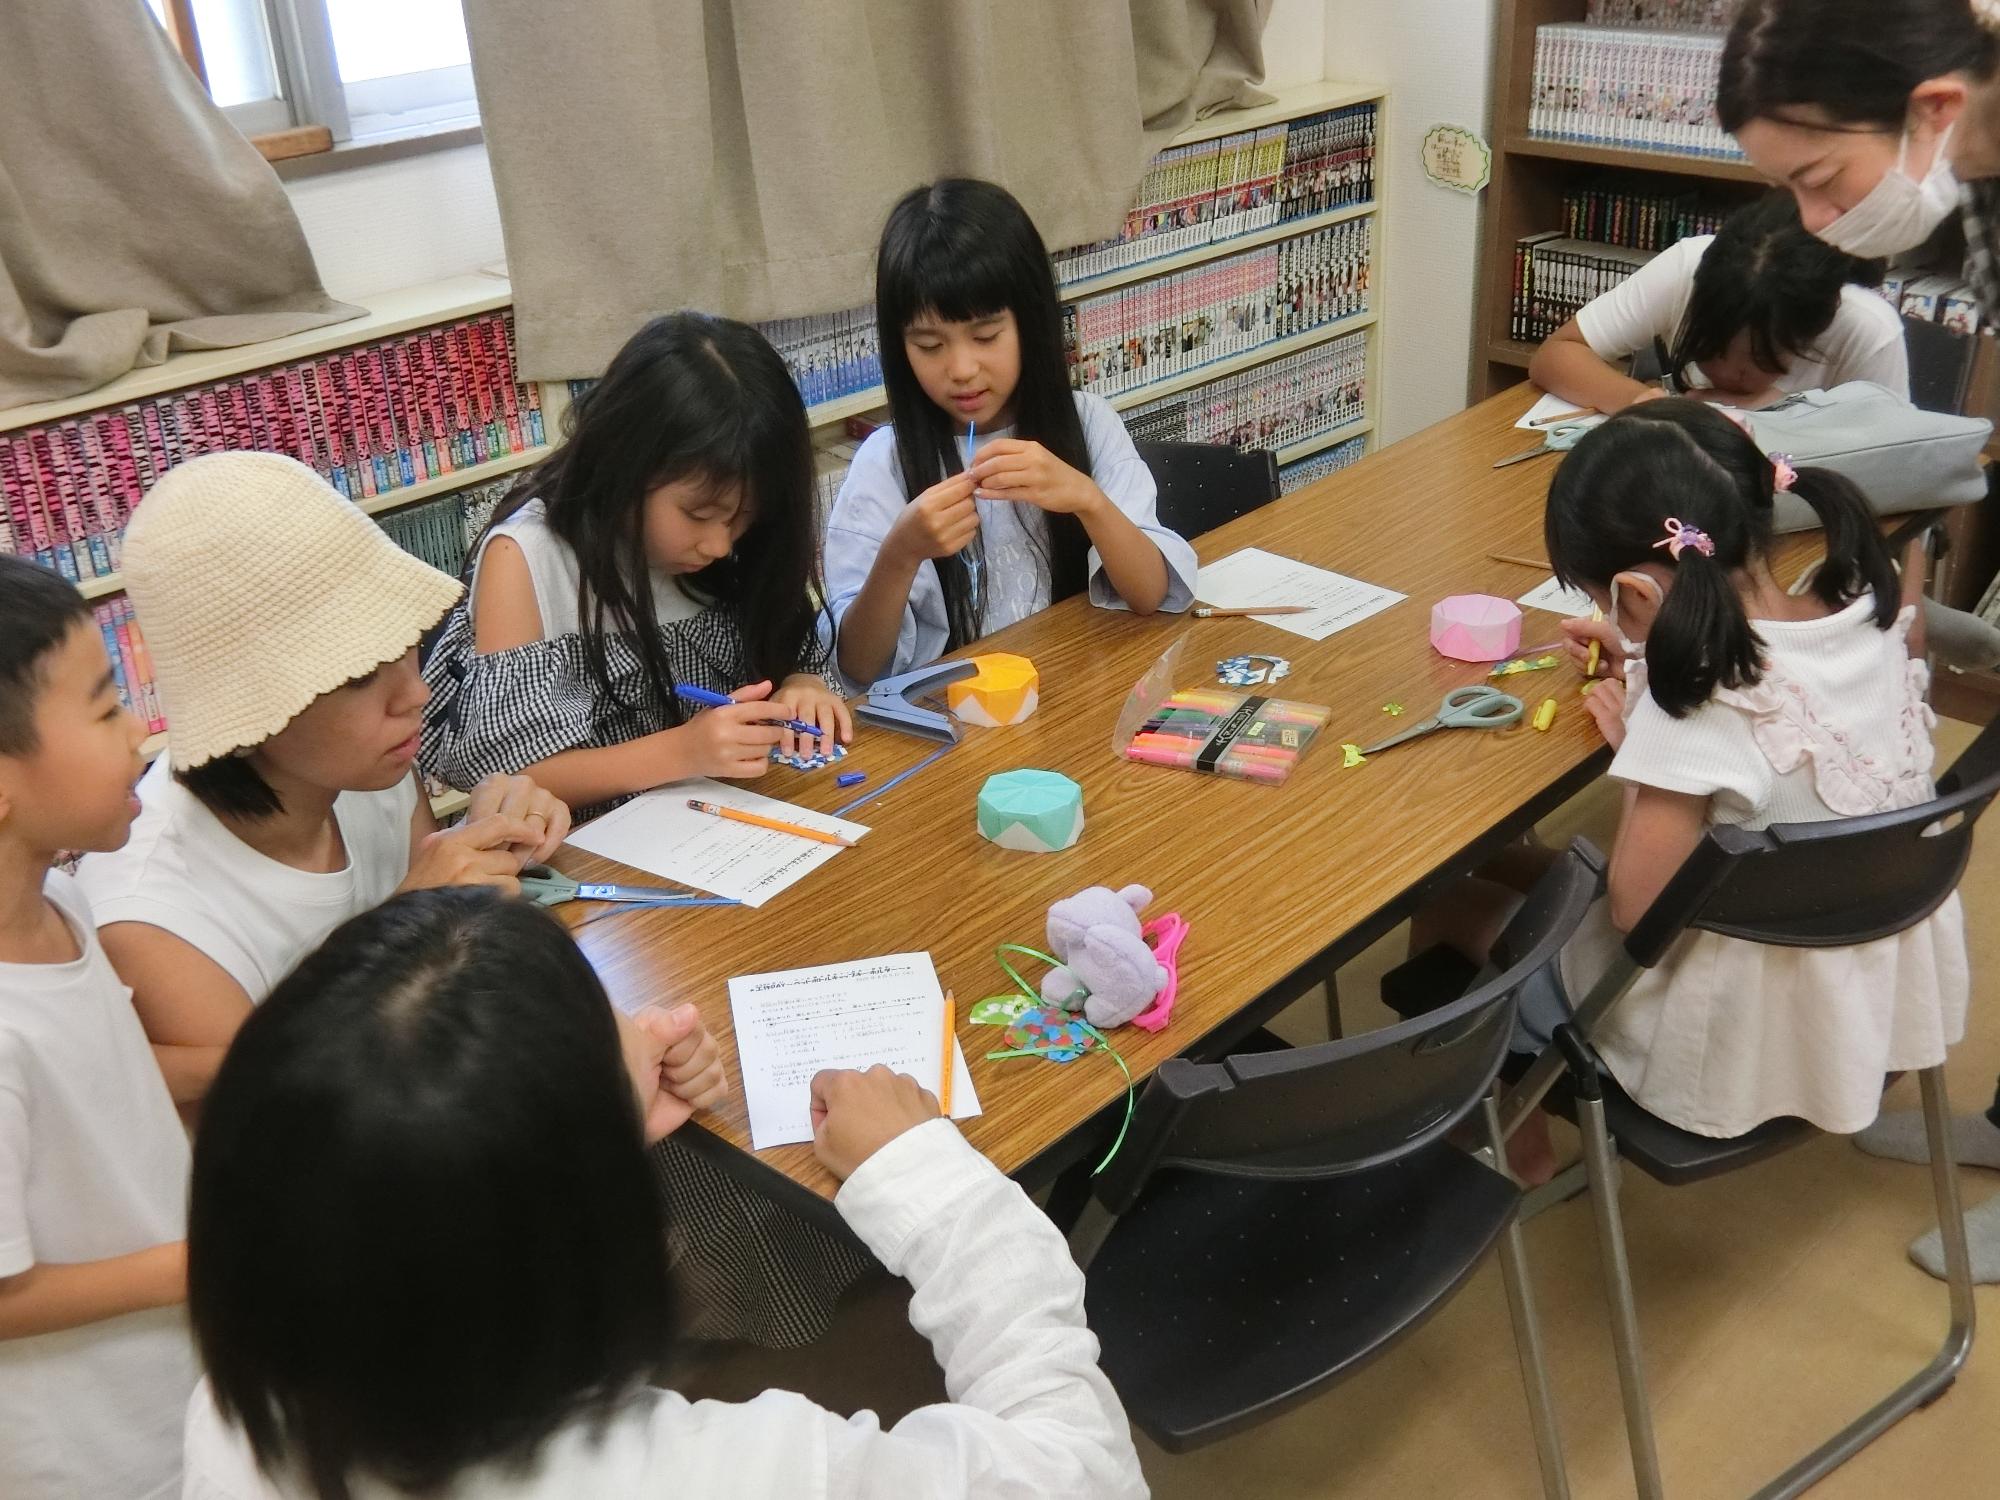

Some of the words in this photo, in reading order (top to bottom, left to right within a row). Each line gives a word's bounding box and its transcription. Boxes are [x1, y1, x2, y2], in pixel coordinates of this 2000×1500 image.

[408, 340, 425, 379] GIANT
[432, 334, 449, 372] GIANT
[457, 327, 473, 365] GIANT
[480, 321, 497, 359] GIANT
[329, 360, 346, 399] GIANT
[357, 354, 373, 393] GIANT
[383, 347, 399, 384] GIANT
[245, 382, 263, 421] GIANT
[274, 375, 291, 415] GIANT
[302, 367, 319, 407] GIANT
[415, 381, 433, 430] KILLING
[439, 374, 457, 423] KILLING
[160, 403, 178, 444] GIANT
[187, 397, 206, 438] GIANT
[217, 389, 235, 429] GIANT
[336, 402, 355, 452] KILLING
[363, 395, 381, 444] KILLING
[389, 387, 408, 437] KILLING
[129, 410, 146, 451] GIANT
[309, 408, 328, 459] KILLING
